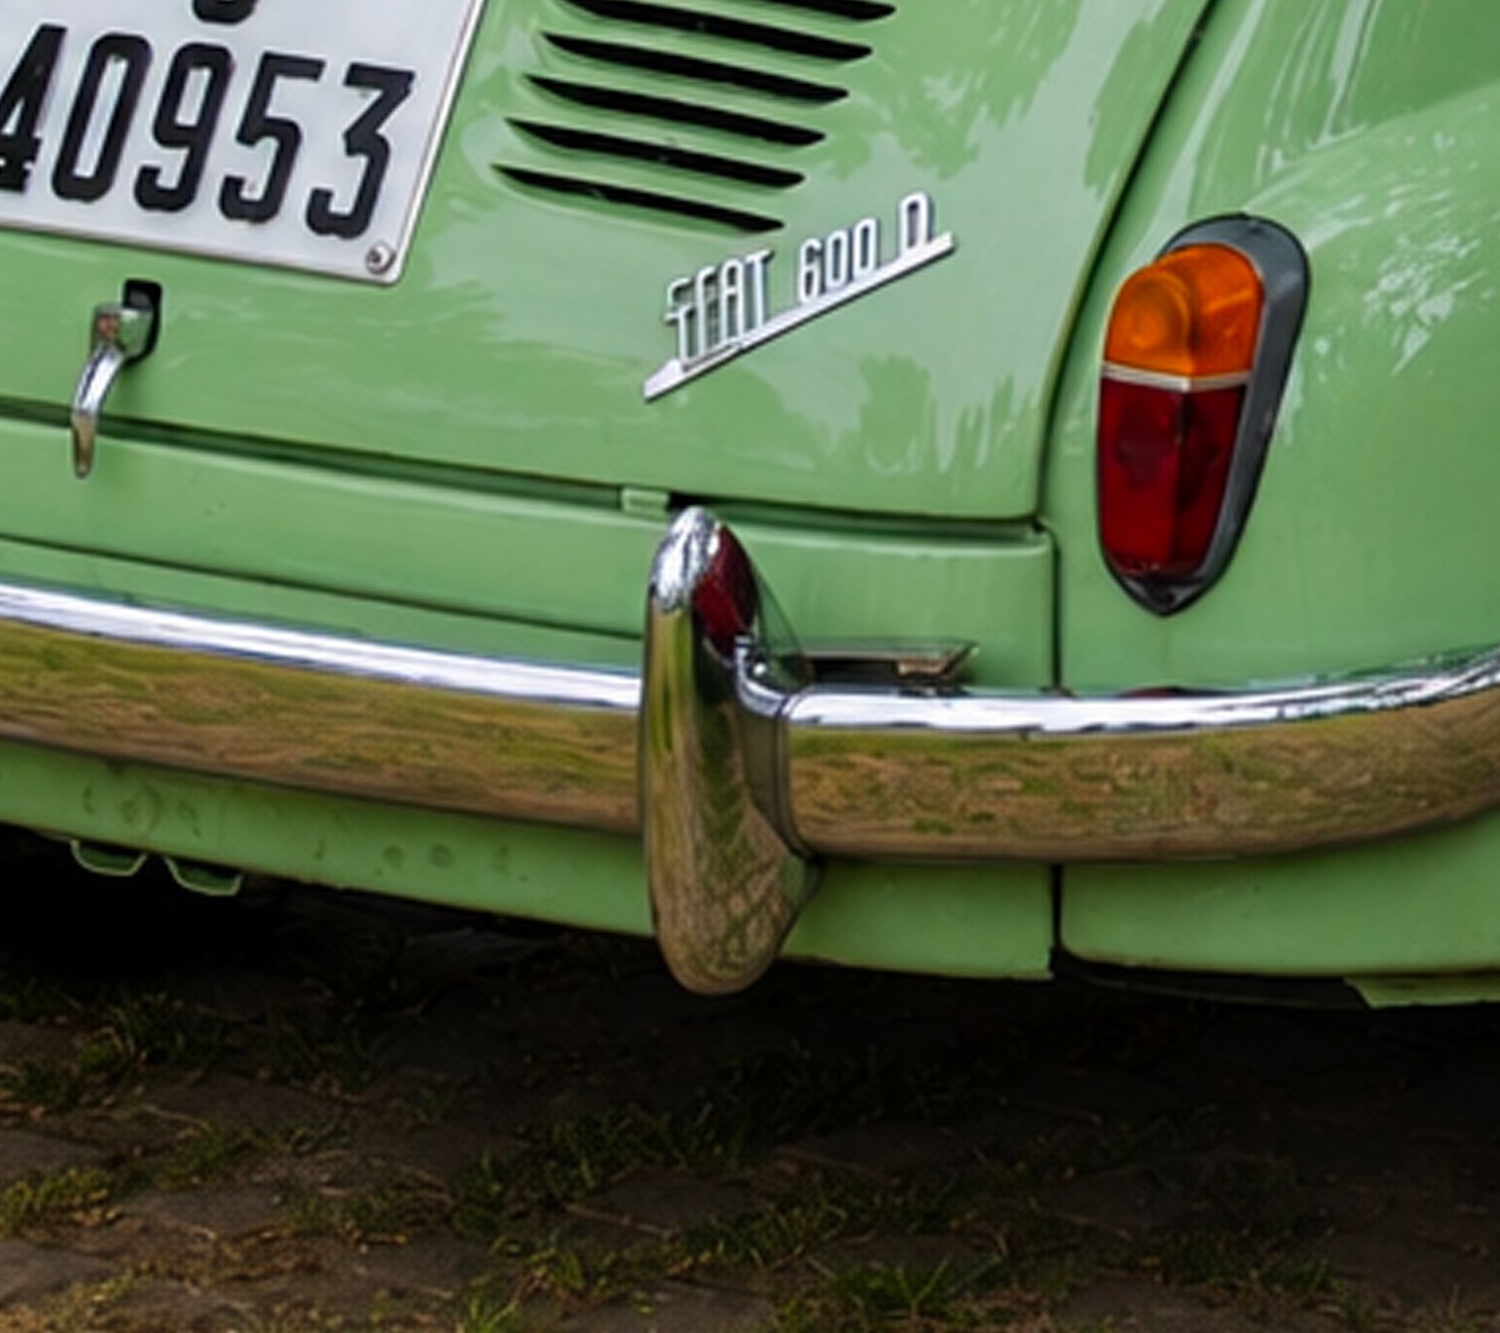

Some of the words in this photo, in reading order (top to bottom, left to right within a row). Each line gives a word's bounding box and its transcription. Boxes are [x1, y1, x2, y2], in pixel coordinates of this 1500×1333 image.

[663, 247, 775, 362] SEAT
[798, 216, 879, 304] 600
[898, 191, 932, 254] D
